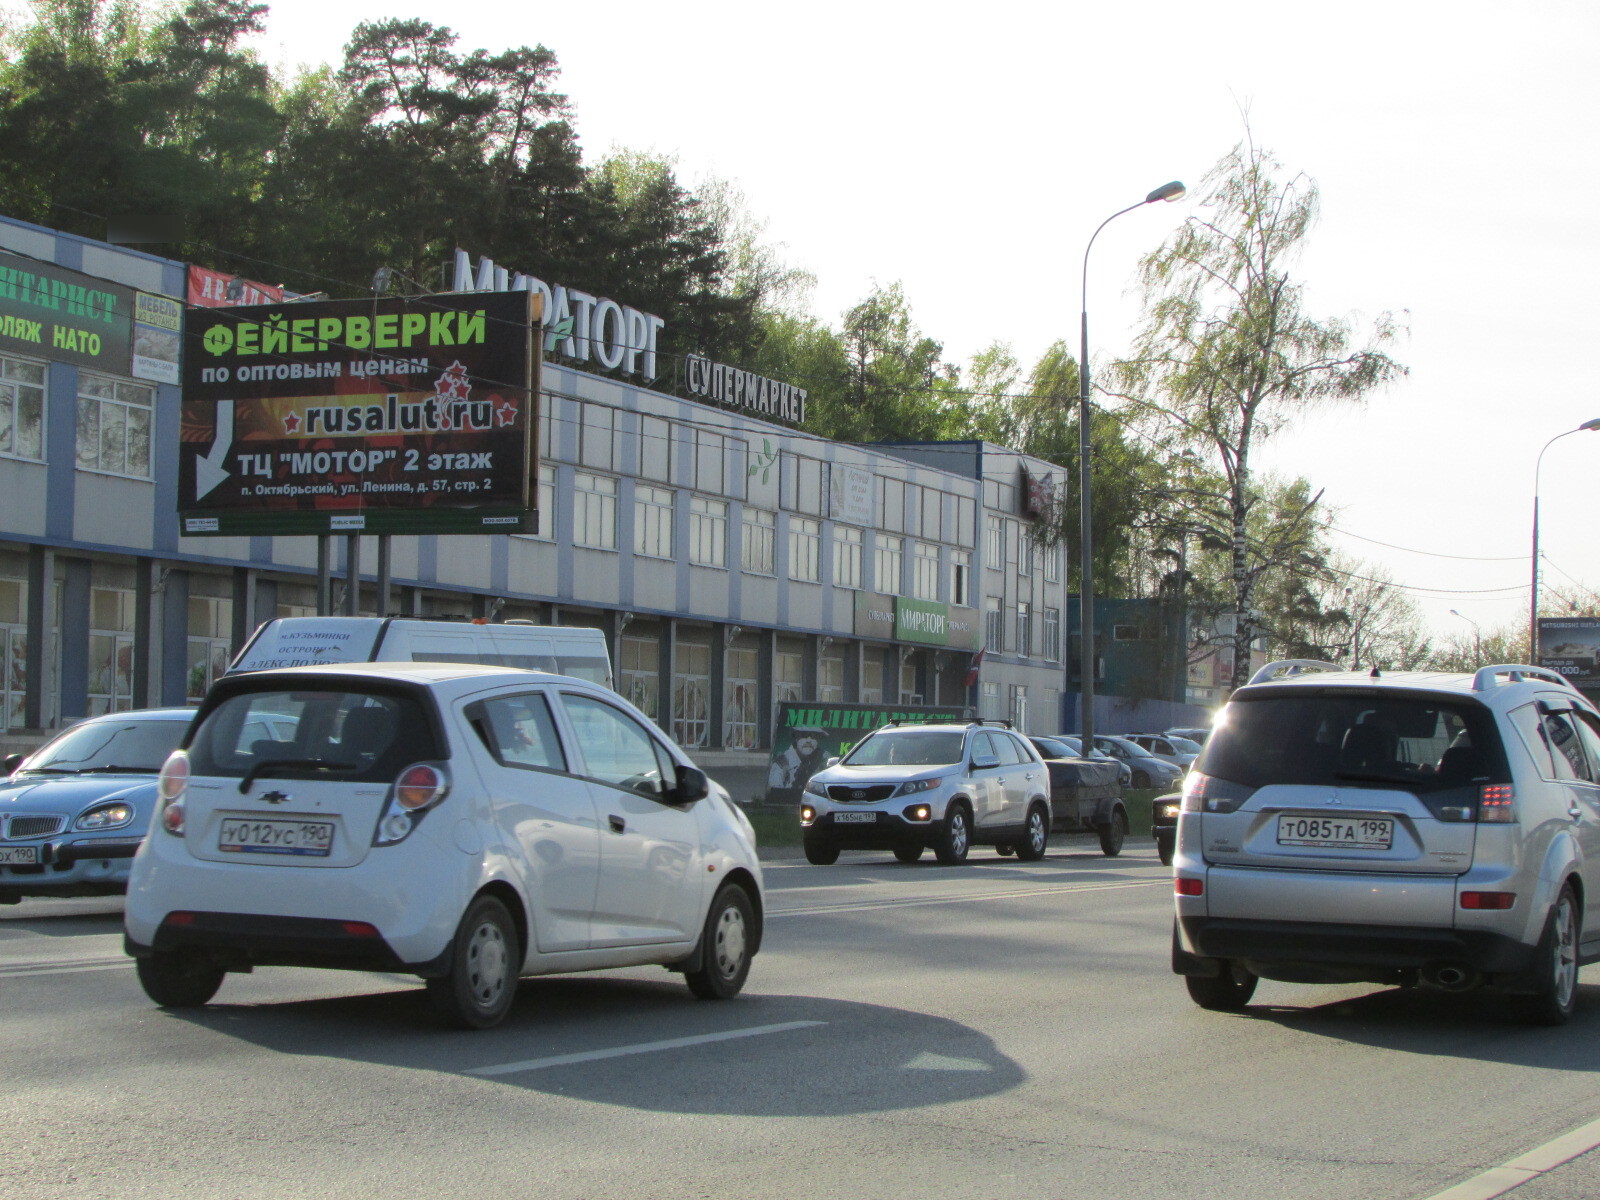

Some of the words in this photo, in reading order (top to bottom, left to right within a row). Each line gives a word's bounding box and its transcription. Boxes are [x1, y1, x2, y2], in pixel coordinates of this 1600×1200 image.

[139, 294, 178, 318] МЕБЕЛЬ
[0, 315, 42, 344] ЛЯЖ
[53, 324, 101, 356] НАТО
[203, 310, 486, 357] ФЕЙЕРВЕРКИ
[202, 367, 229, 383] по
[237, 361, 341, 382] оптовым
[350, 358, 428, 380] ценам
[685, 353, 808, 424] СУПЕРМАРКЕТ
[305, 394, 494, 435] rusalut.ru
[238, 453, 272, 479] ТЦ
[280, 449, 397, 475] "МОТОР"
[403, 448, 420, 472] 2
[427, 452, 493, 471] этаж
[241, 487, 252, 496] п.
[255, 482, 338, 497] Октябрьский,
[341, 484, 359, 495] ул.
[362, 481, 414, 494] Ленина,
[417, 480, 429, 492] д.
[432, 479, 451, 493] 57,
[454, 479, 480, 493] стр.
[483, 478, 492, 490] 2
[901, 608, 945, 634] МИРАТОРГ
[278, 646, 332, 655] ОСТРОВ
[247, 660, 340, 669] ЭЛЕКС-ПОЛ
[853, 791, 866, 799] KIA
[300, 825, 328, 841] 190
[1286, 820, 1355, 839] Т085ТА
[1360, 821, 1387, 836] 199
[14, 848, 33, 859] 190
